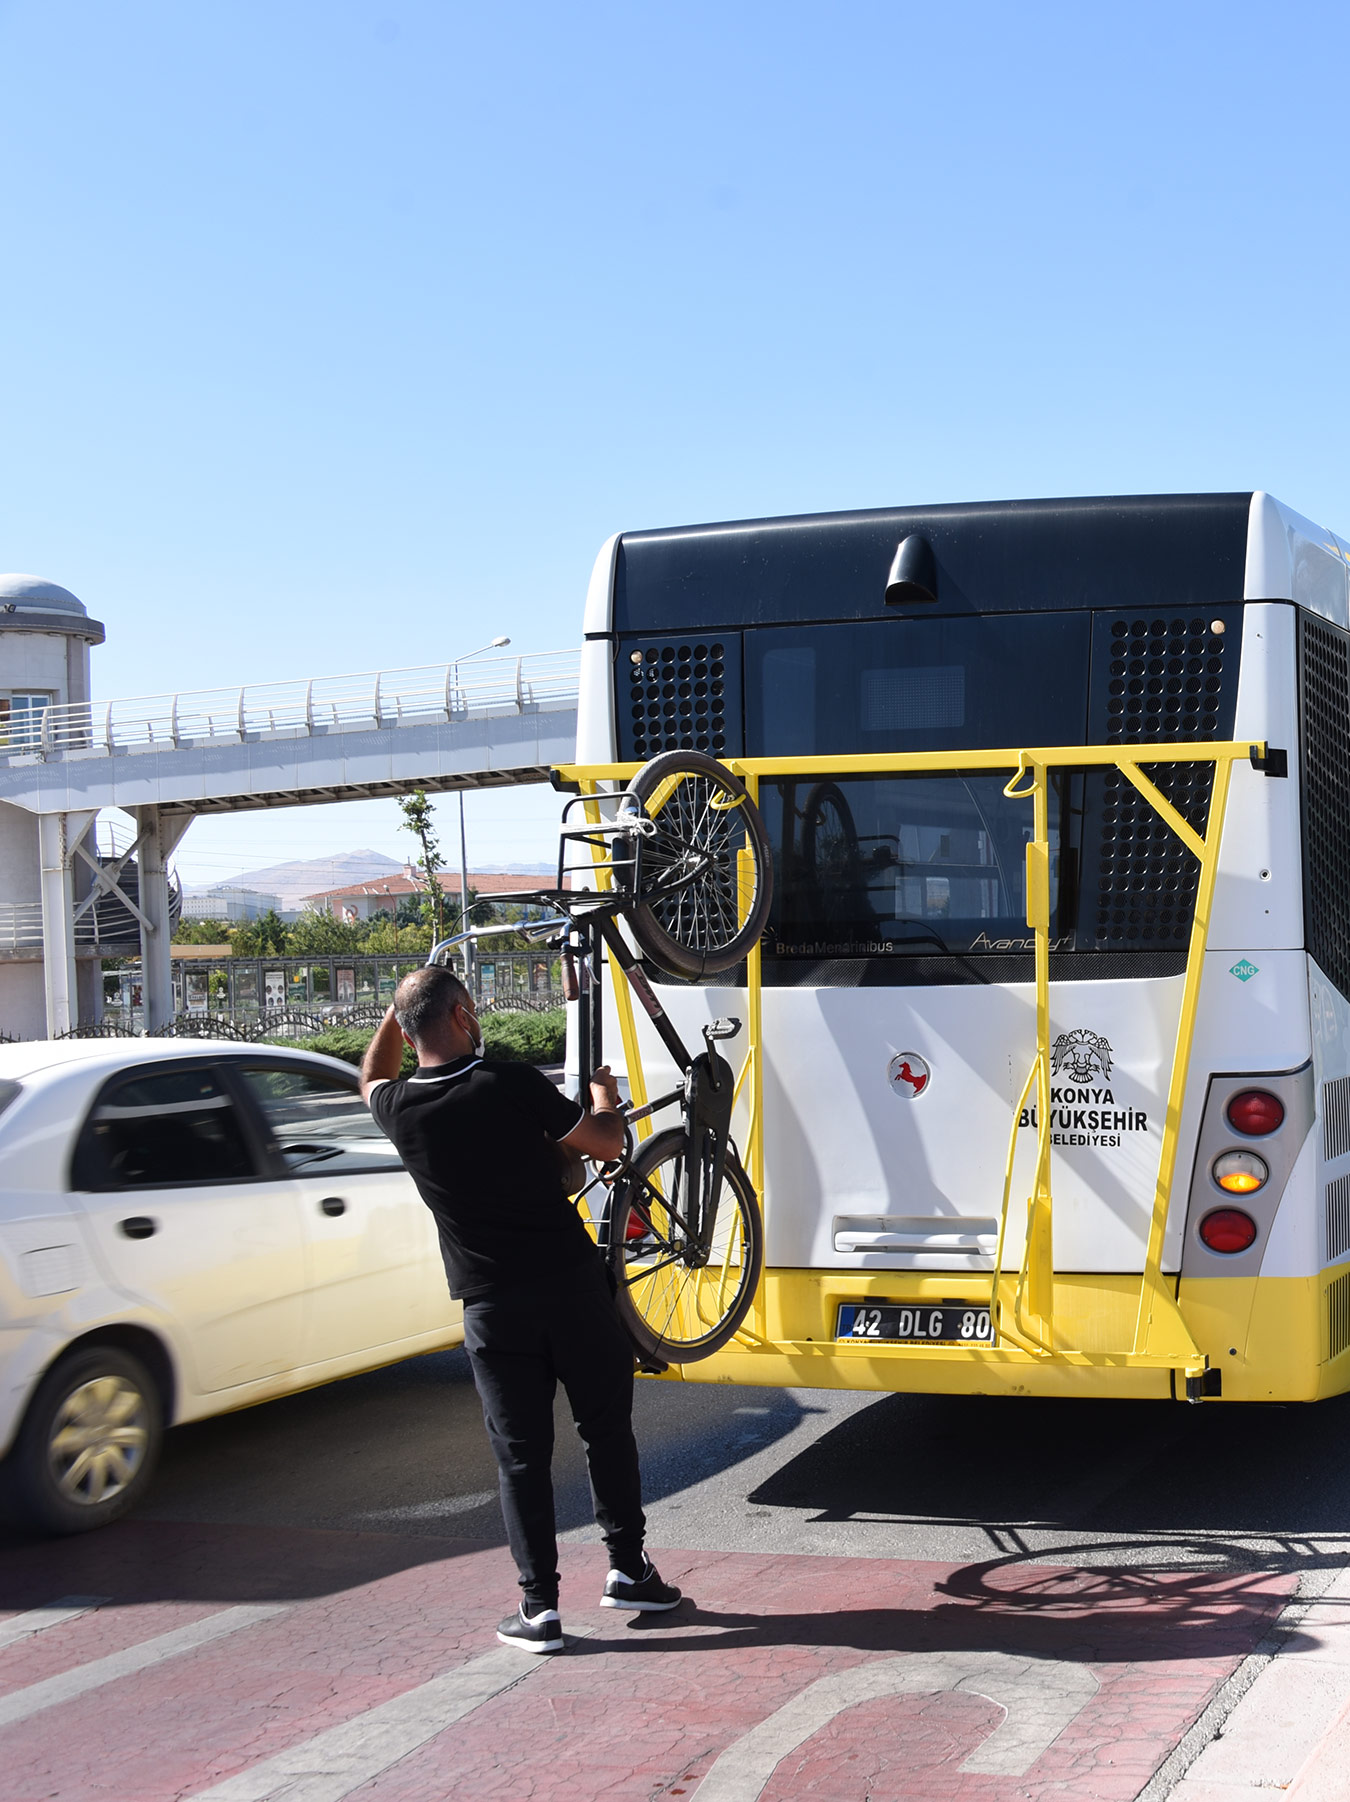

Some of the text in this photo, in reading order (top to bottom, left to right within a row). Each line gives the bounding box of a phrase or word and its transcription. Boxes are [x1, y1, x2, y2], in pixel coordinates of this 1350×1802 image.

[1233, 965, 1255, 976] CNG
[1051, 1088, 1115, 1105] KONYA
[852, 1309, 990, 1339] 42 DLG 80
